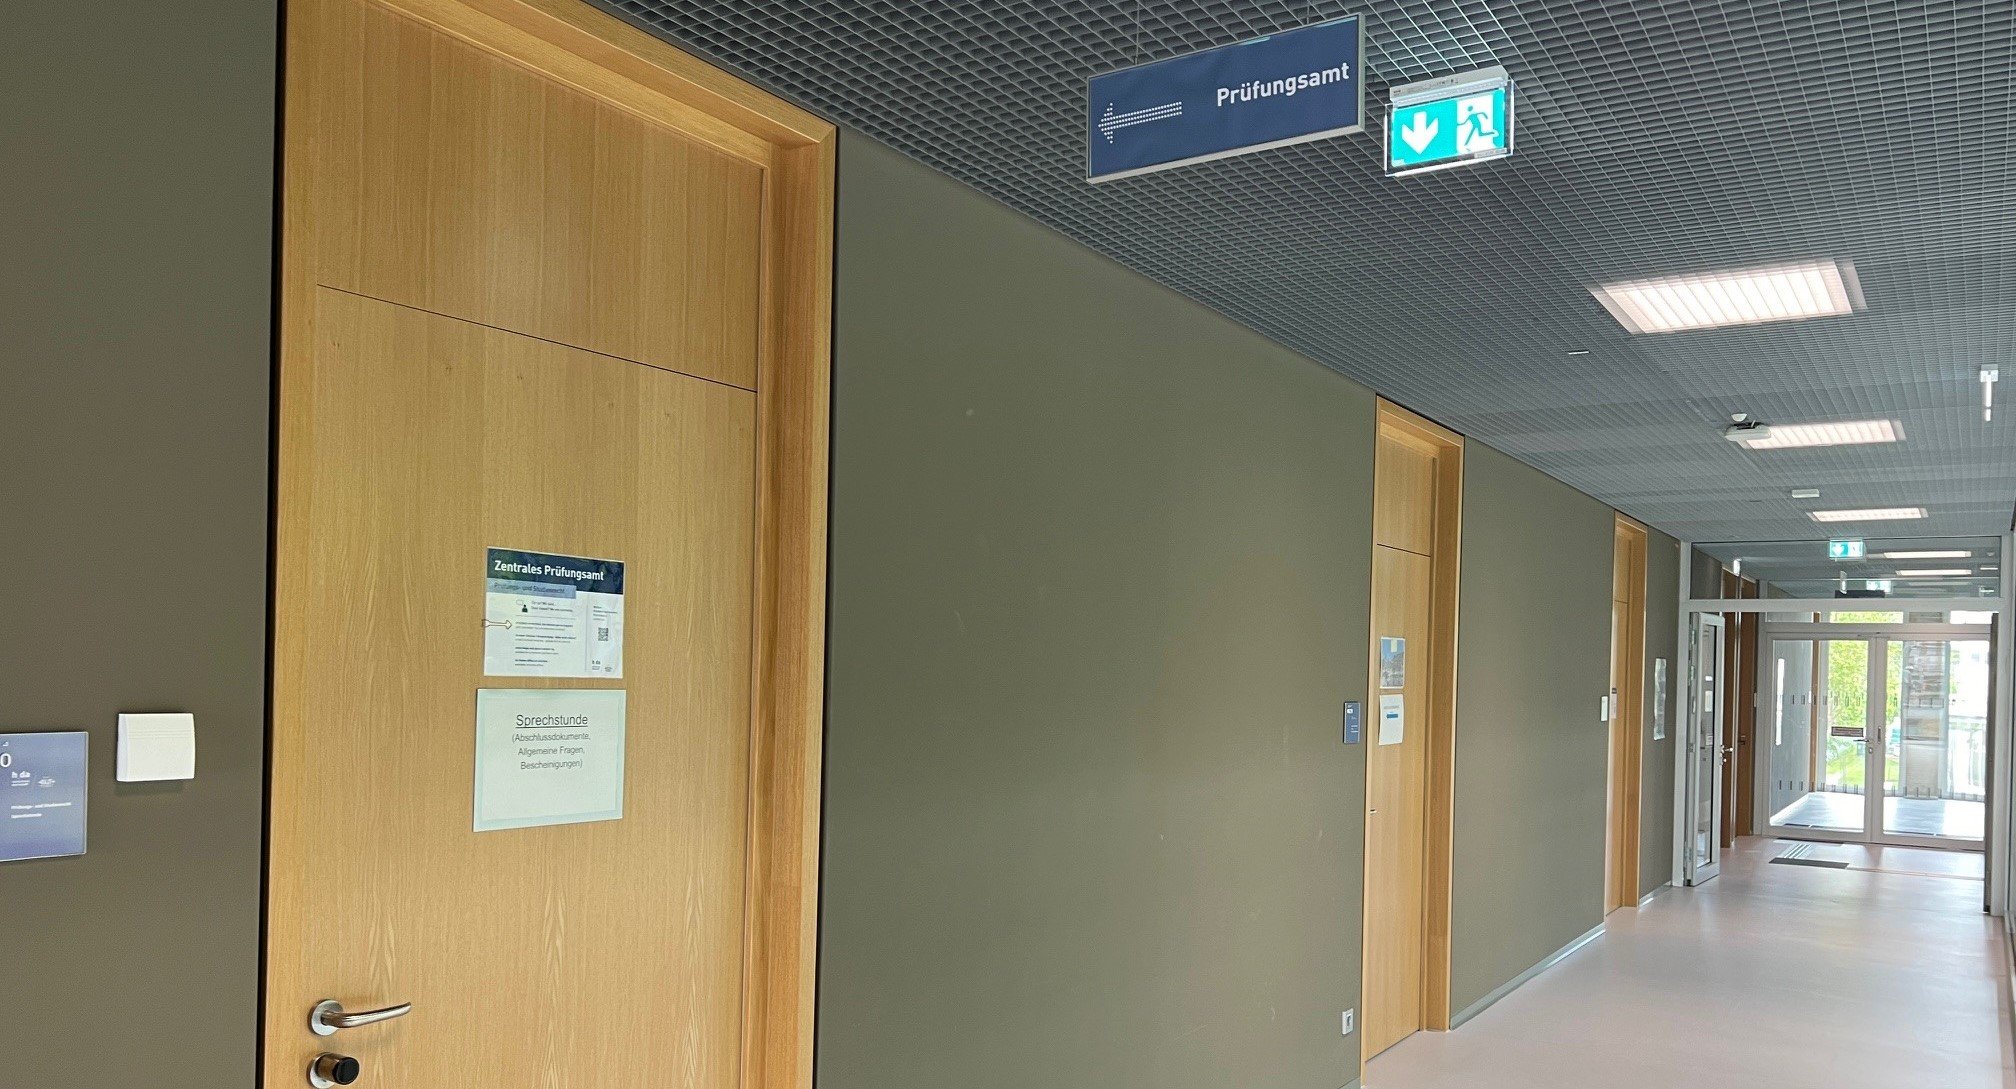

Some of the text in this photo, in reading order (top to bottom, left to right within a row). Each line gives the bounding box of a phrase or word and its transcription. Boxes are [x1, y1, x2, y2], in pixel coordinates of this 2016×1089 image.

[1217, 62, 1350, 107] Prüfungsamt
[494, 560, 604, 581] Zentrales Prüfungsamt
[516, 714, 588, 728] Sprechstunde
[512, 733, 591, 743] (Abschlussdokumente,
[518, 746, 585, 757] Allgemeine Fragen,
[521, 759, 583, 770] Bescheinigungen)
